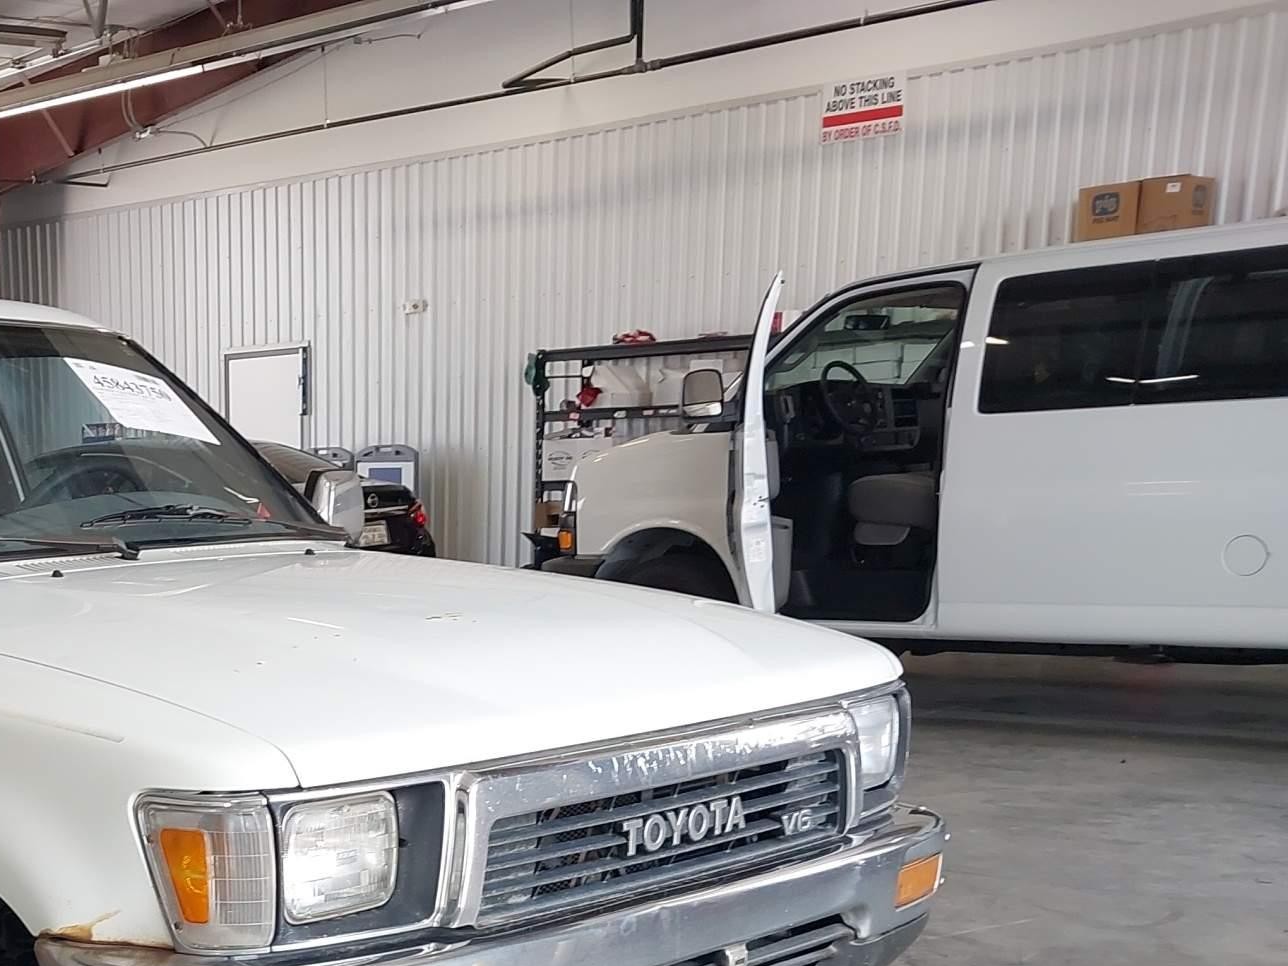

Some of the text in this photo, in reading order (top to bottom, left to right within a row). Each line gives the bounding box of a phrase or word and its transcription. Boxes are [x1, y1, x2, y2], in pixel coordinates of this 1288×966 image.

[833, 76, 896, 98] NO STACKING
[825, 89, 904, 113] ABOVE THIS LINE
[822, 130, 832, 142] BY
[834, 126, 860, 141] ORDER
[861, 124, 872, 137] OF
[622, 795, 748, 857] TOYOTA
[781, 808, 813, 836] V6
